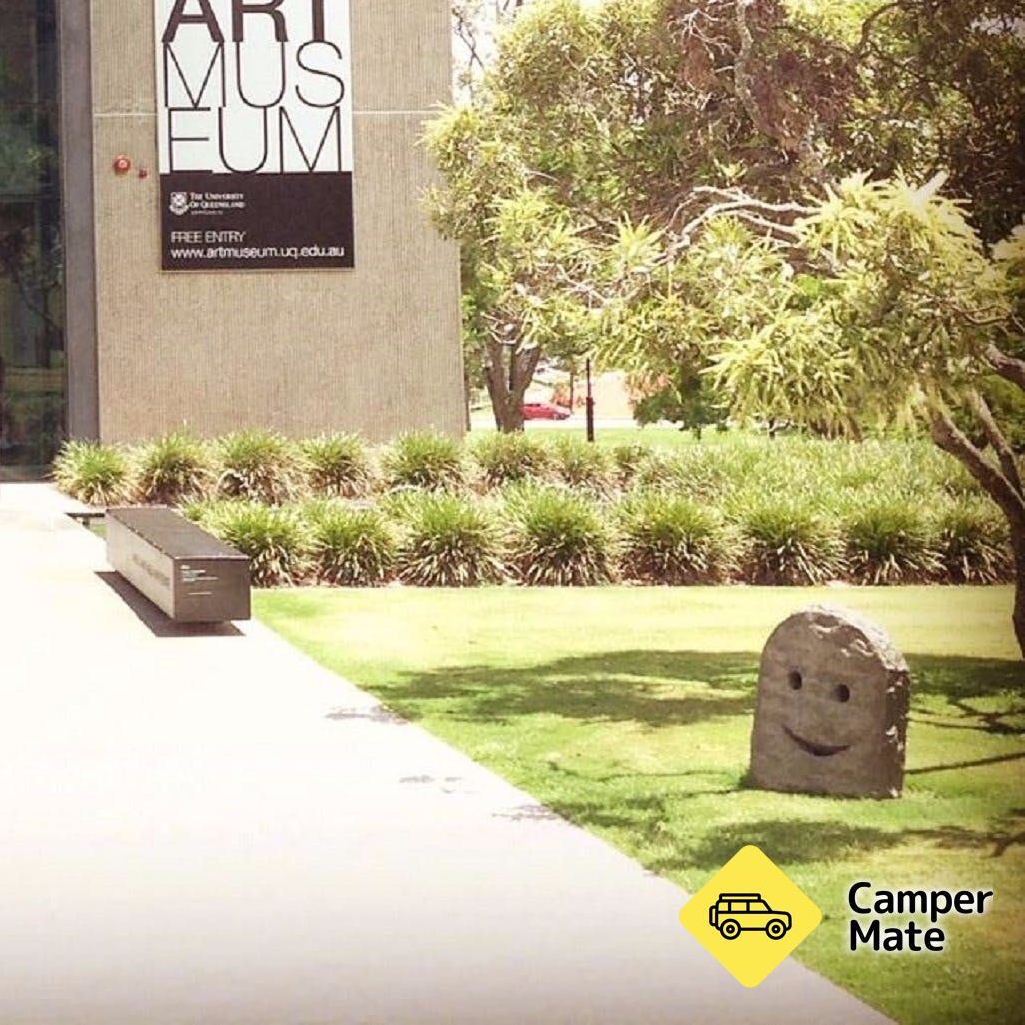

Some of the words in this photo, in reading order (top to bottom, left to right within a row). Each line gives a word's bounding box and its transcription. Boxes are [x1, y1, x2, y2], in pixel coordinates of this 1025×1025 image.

[171, 231, 203, 243] FREE
[205, 231, 246, 243] ENTRY
[171, 245, 345, 259] www.artmuseum.uq.edu.au
